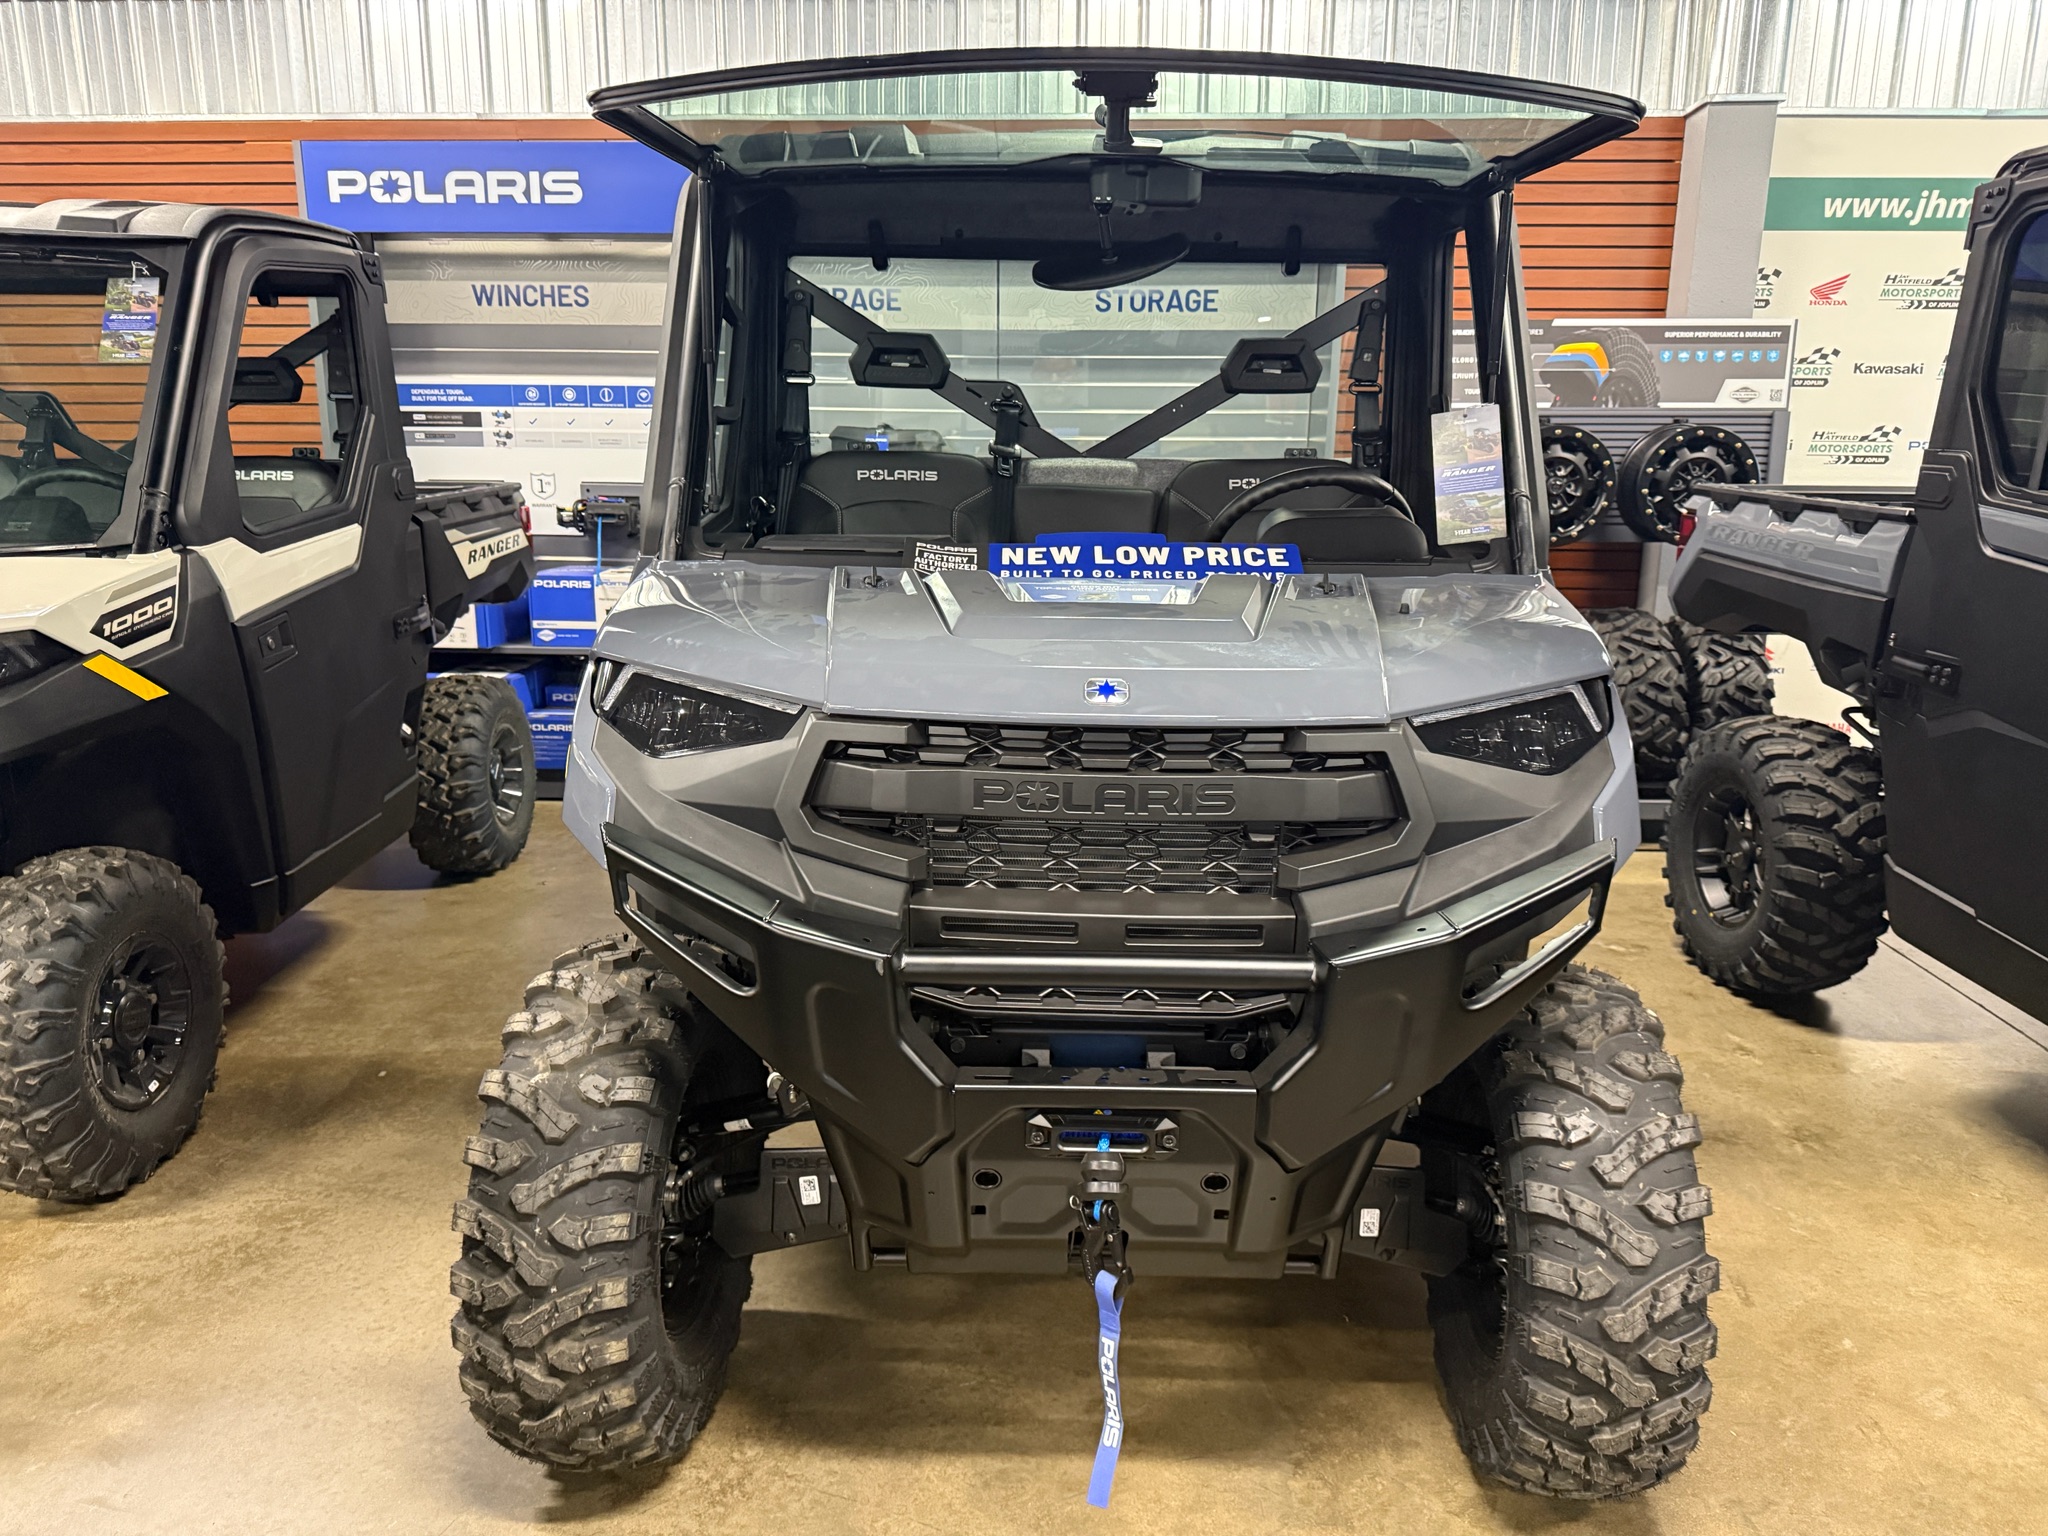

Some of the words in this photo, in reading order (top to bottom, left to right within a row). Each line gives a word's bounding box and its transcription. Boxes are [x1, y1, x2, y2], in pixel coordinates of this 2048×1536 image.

[327, 170, 583, 204] POLARIS
[1884, 274, 1932, 285] HATFIELD
[471, 284, 589, 308] WINCHES
[821, 287, 902, 312] RAGE
[1095, 288, 1219, 314] STORAGE
[1853, 362, 1924, 375] Kawasaki
[1812, 431, 1859, 441] HATFIELD
[1808, 444, 1893, 454] MOTORSPORTS
[857, 469, 939, 481] POLARIS
[1228, 478, 1260, 490] PO
[467, 533, 521, 565] RANGER
[916, 541, 978, 553] POLARIS
[1711, 523, 1816, 562] RANGER
[914, 557, 978, 571] AUTHORIZED
[923, 552, 969, 564] FACTORY
[1001, 546, 1081, 566] NEW
[1094, 546, 1178, 566] LOW
[1183, 547, 1290, 567] PRICE
[1001, 569, 1053, 578] BUILT
[1061, 570, 1084, 578] TO
[1092, 569, 1122, 578] GO.
[1130, 570, 1197, 580] PRICED
[533, 579, 592, 589] POLARIS
[102, 596, 173, 637] 1000
[111, 628, 131, 640] SINGLE
[162, 610, 174, 618] CAM
[973, 778, 1237, 816] POLARIS
[1101, 1336, 1121, 1449] POLARIS
